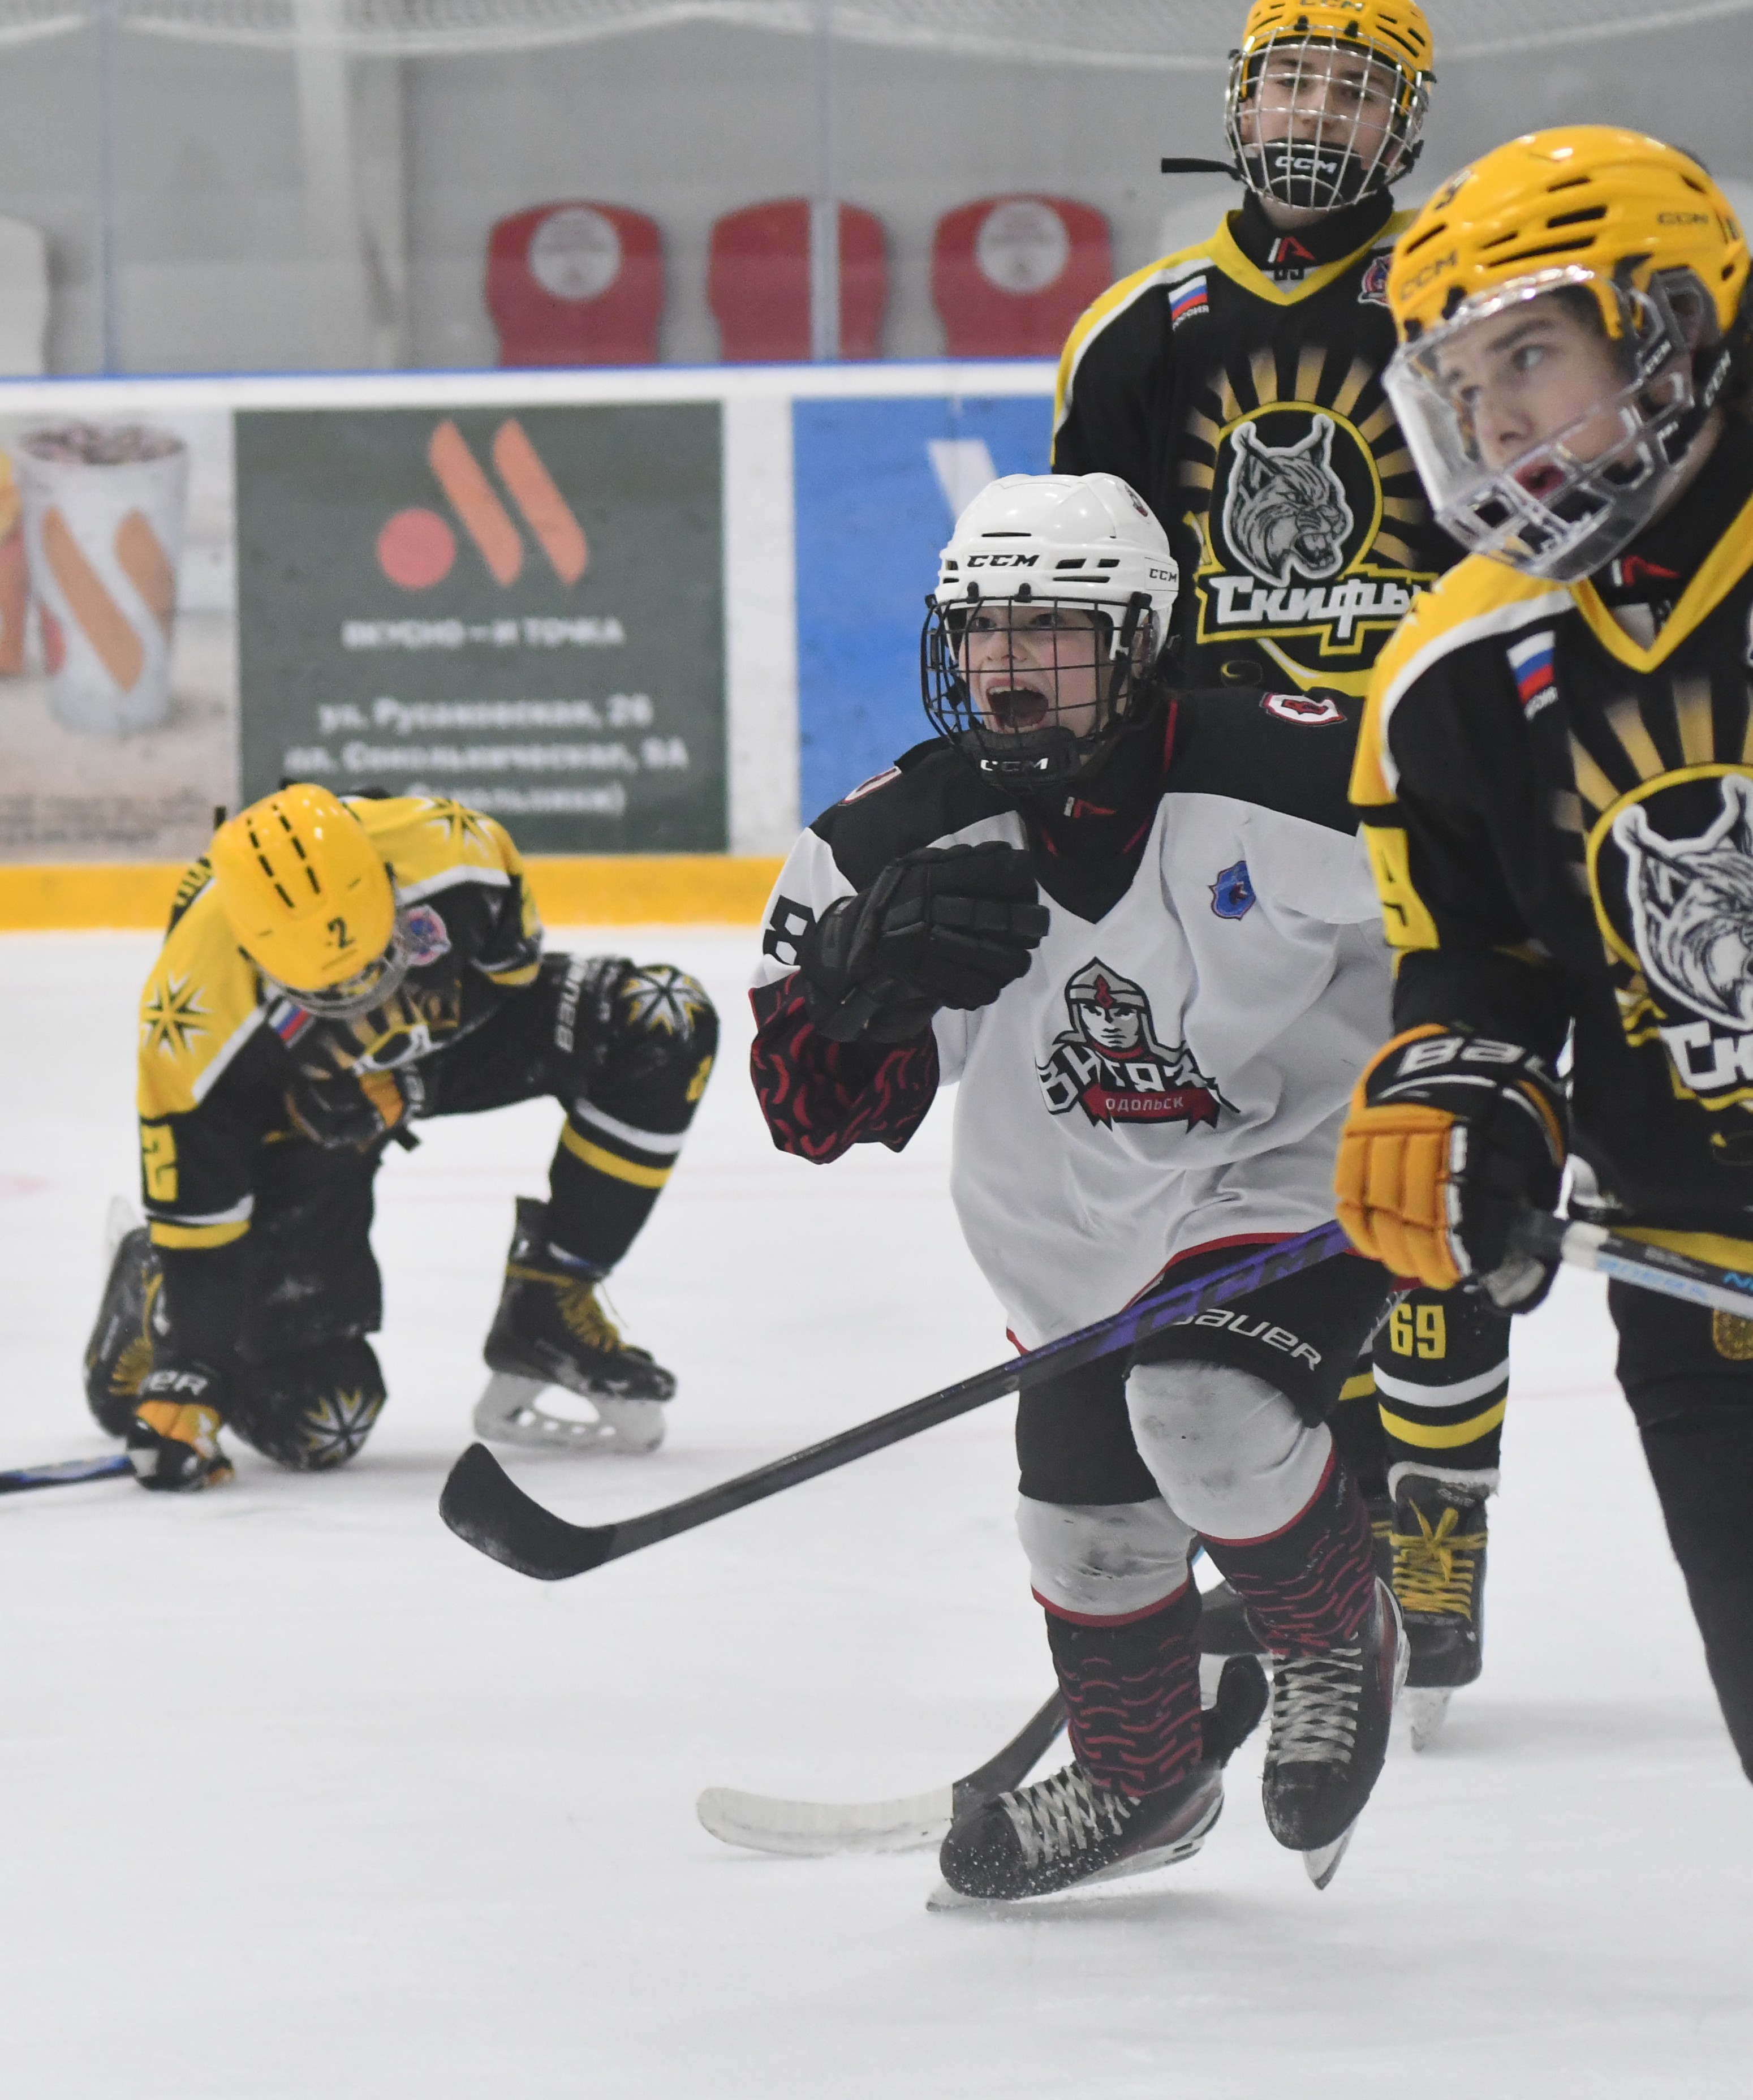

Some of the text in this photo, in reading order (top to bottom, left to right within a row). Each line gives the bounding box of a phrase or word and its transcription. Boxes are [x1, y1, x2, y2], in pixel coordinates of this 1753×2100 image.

[1274, 156, 1337, 174] CCM
[1656, 211, 1709, 225] CCM
[1400, 249, 1458, 301] CCM
[967, 554, 1040, 567] CCM
[1149, 567, 1177, 582] CCM
[980, 756, 1048, 771] CCM
[326, 916, 356, 949] 2
[762, 894, 819, 967] 8
[1389, 1303, 1446, 1358] 69
